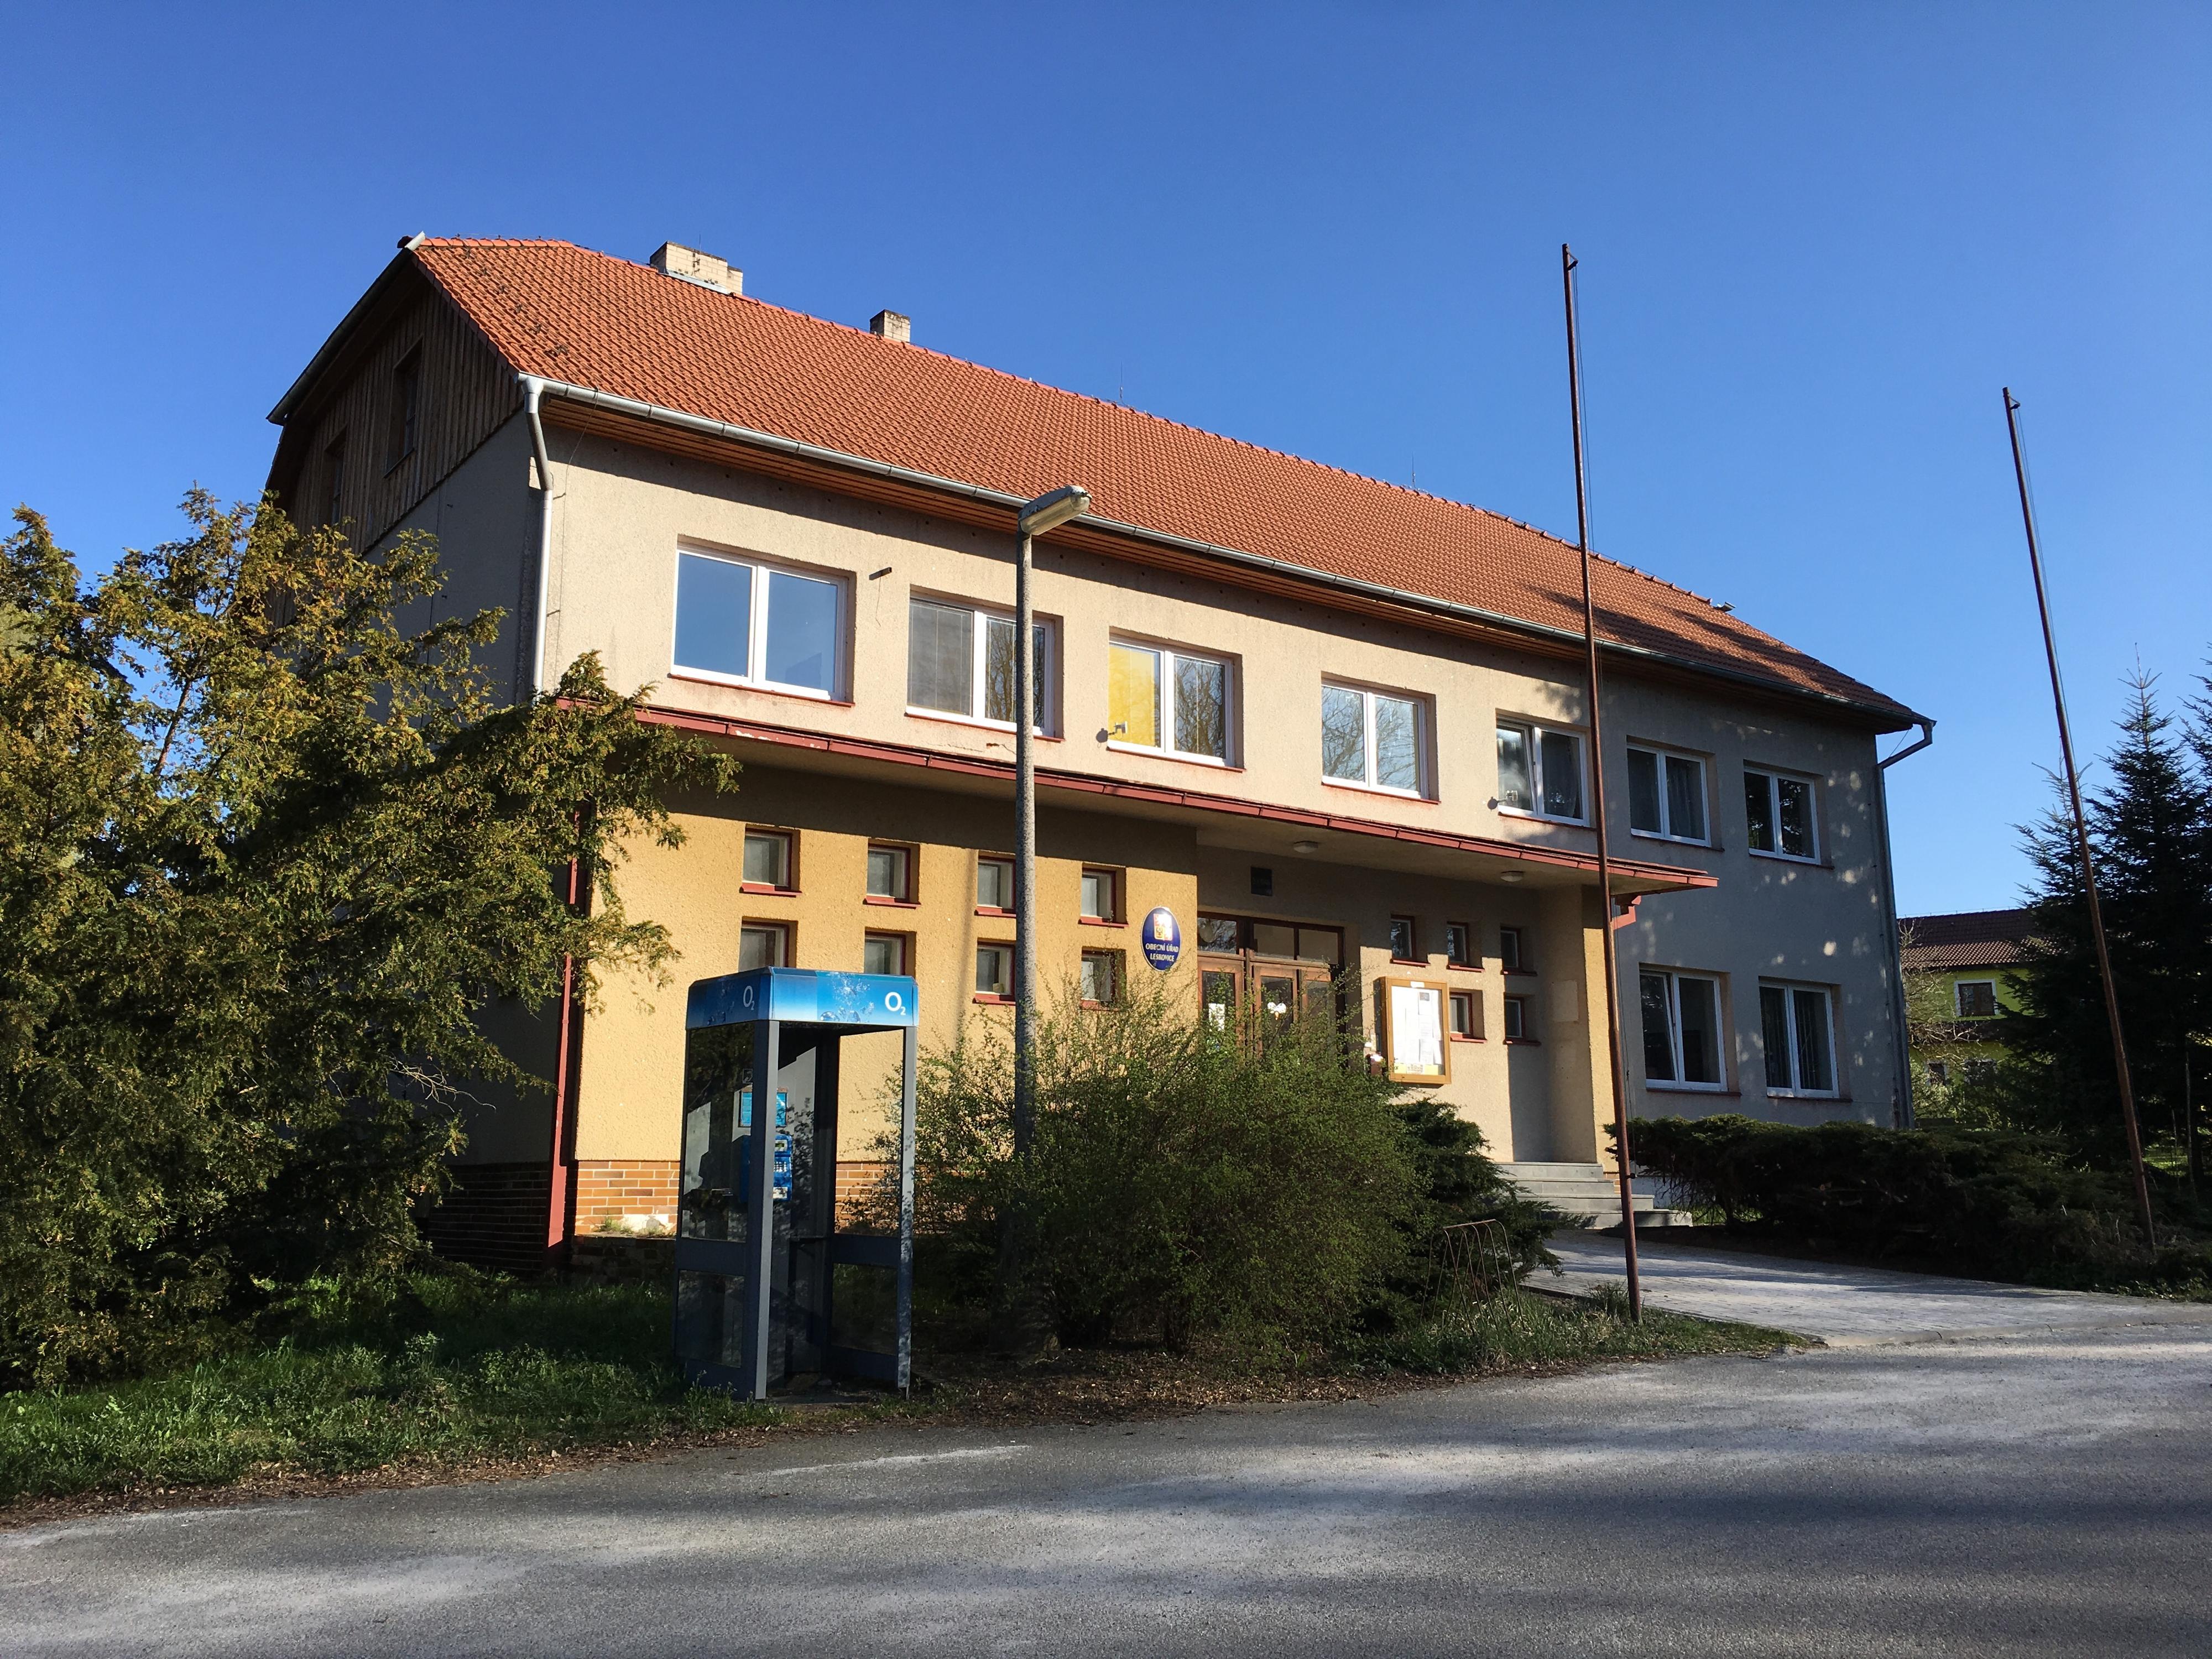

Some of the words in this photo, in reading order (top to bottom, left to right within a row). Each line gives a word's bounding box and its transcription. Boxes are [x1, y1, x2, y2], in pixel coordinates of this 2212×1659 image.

[1166, 943, 1178, 952] ÚŘAD
[1150, 953, 1175, 962] LESKOVICE
[743, 985, 755, 1011] O2
[885, 992, 906, 1015] O2
